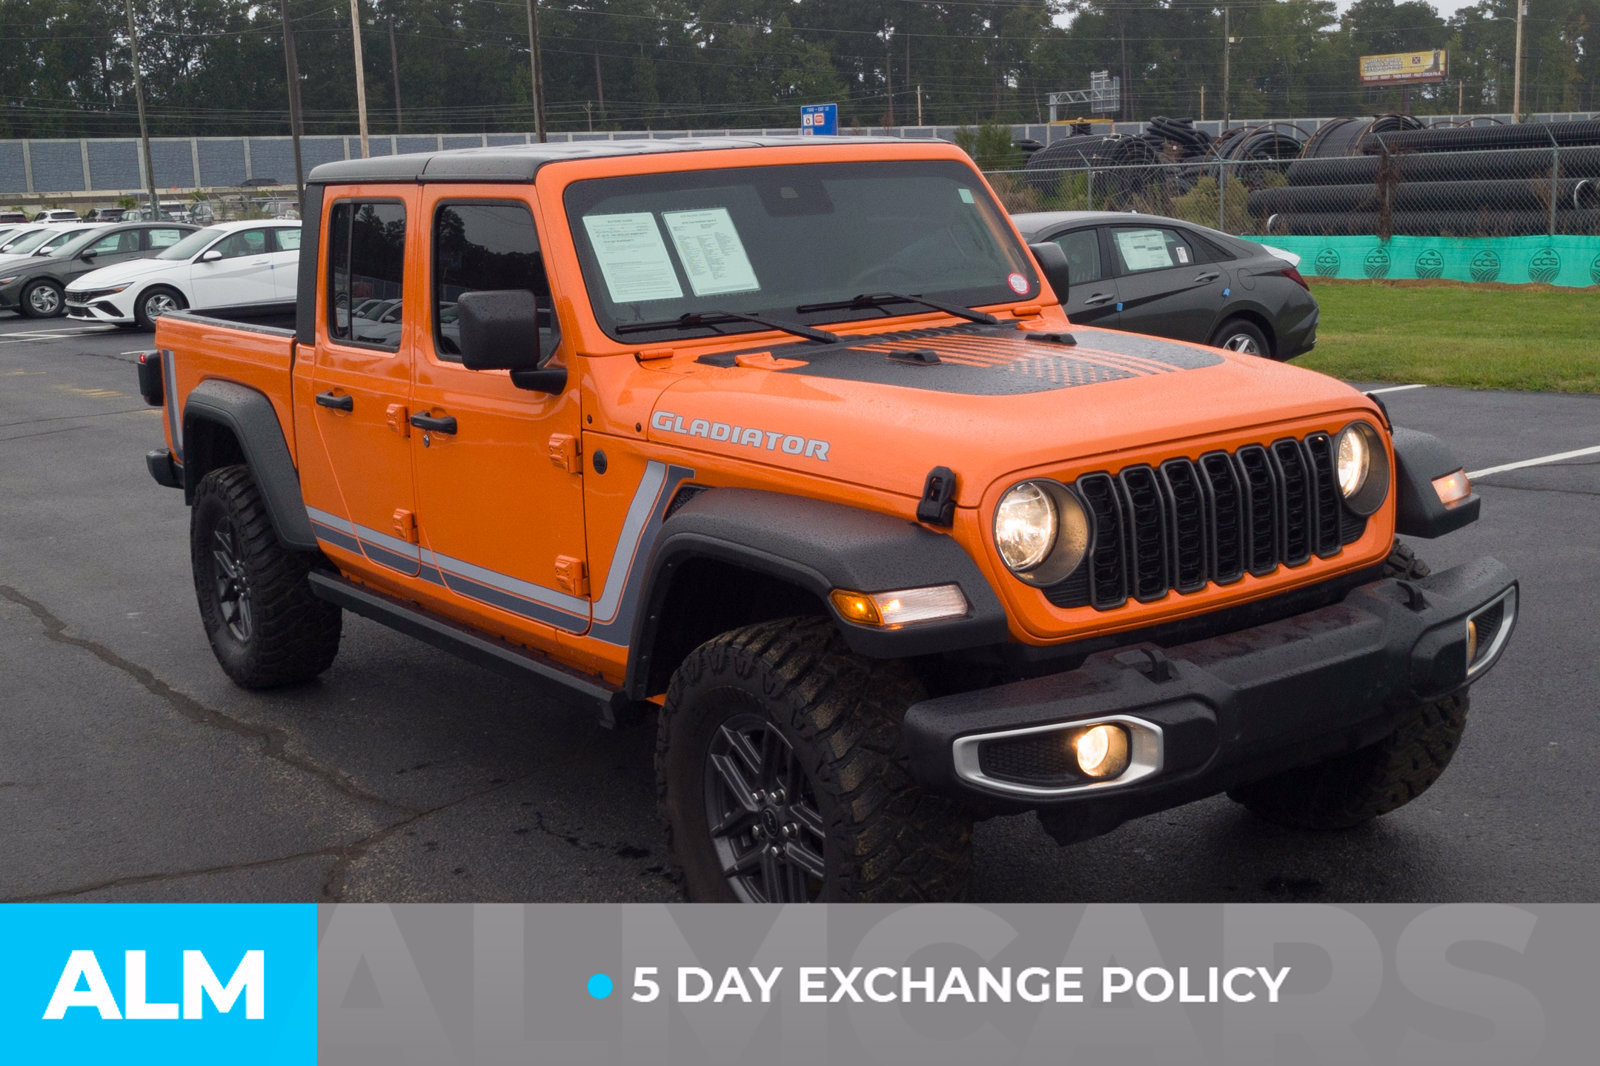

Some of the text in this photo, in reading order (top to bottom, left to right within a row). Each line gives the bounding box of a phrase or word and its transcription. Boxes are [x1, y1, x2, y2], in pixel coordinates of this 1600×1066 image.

[1318, 256, 1338, 264] CCS
[1366, 255, 1389, 264] CCS
[1418, 257, 1442, 266] CCS
[1473, 258, 1499, 267] CCS
[1532, 257, 1559, 267] CCS
[651, 410, 830, 461] GLADIATOR
